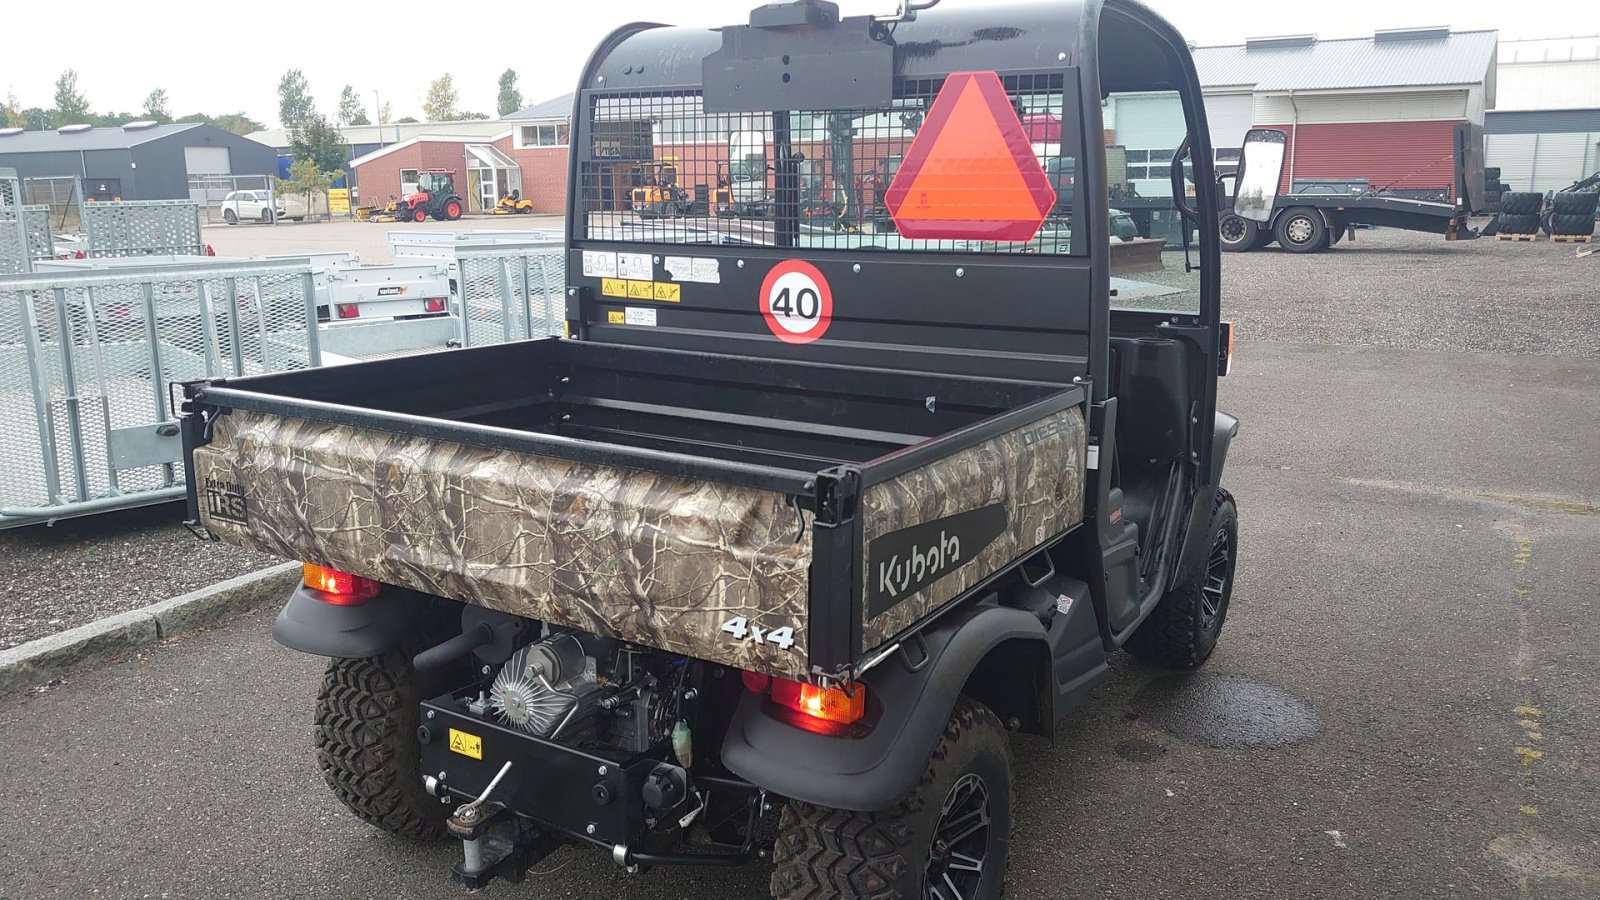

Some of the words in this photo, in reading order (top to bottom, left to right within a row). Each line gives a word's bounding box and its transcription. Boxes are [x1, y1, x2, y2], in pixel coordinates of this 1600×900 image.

[772, 288, 819, 319] 40
[1023, 413, 1077, 446] DIESEL
[879, 530, 960, 597] Kubota
[721, 616, 795, 651] 4x4
